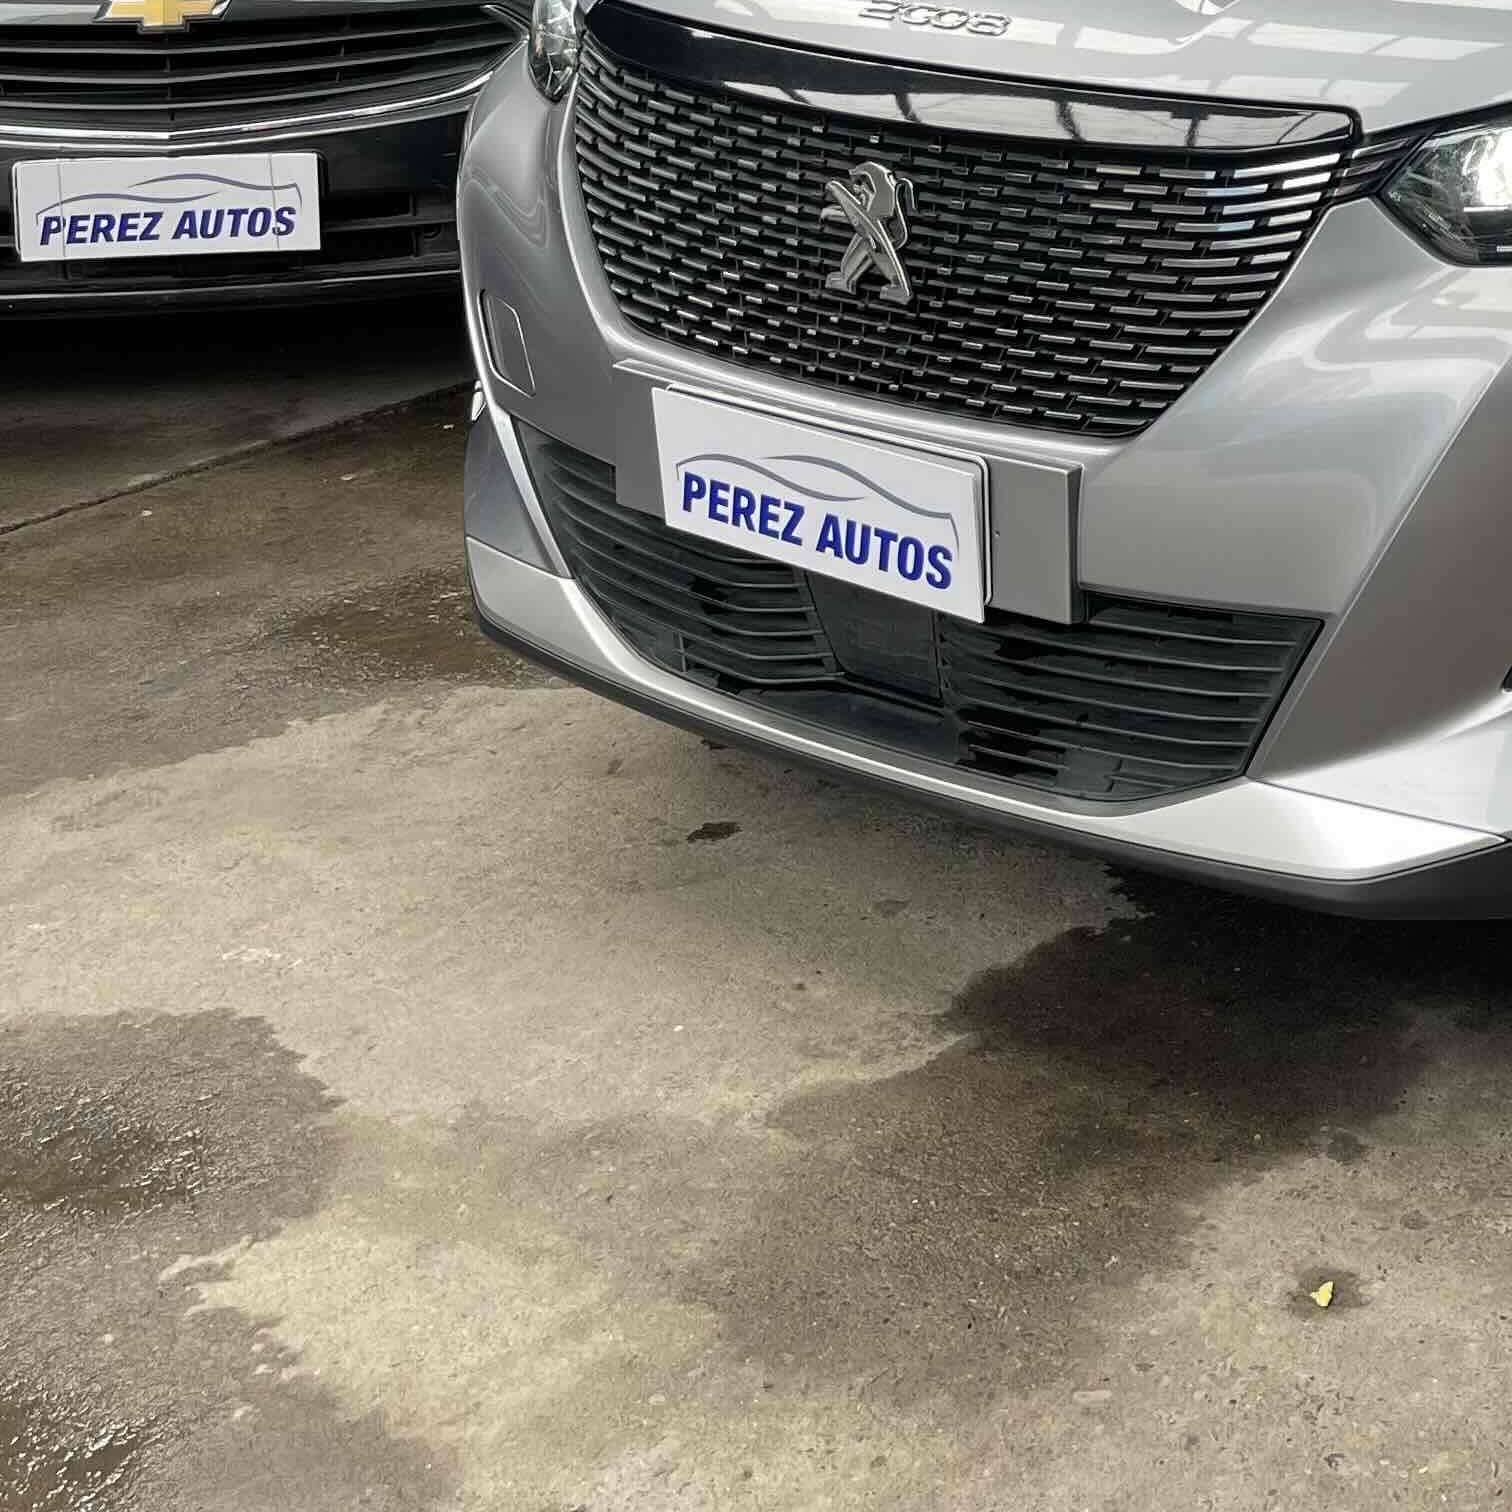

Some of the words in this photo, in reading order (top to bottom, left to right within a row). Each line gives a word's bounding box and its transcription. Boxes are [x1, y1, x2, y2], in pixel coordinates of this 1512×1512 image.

[39, 210, 164, 246] PEREZ
[171, 205, 297, 241] AUTOS
[681, 471, 807, 547] PEREZ
[815, 512, 954, 591] AUTOS
